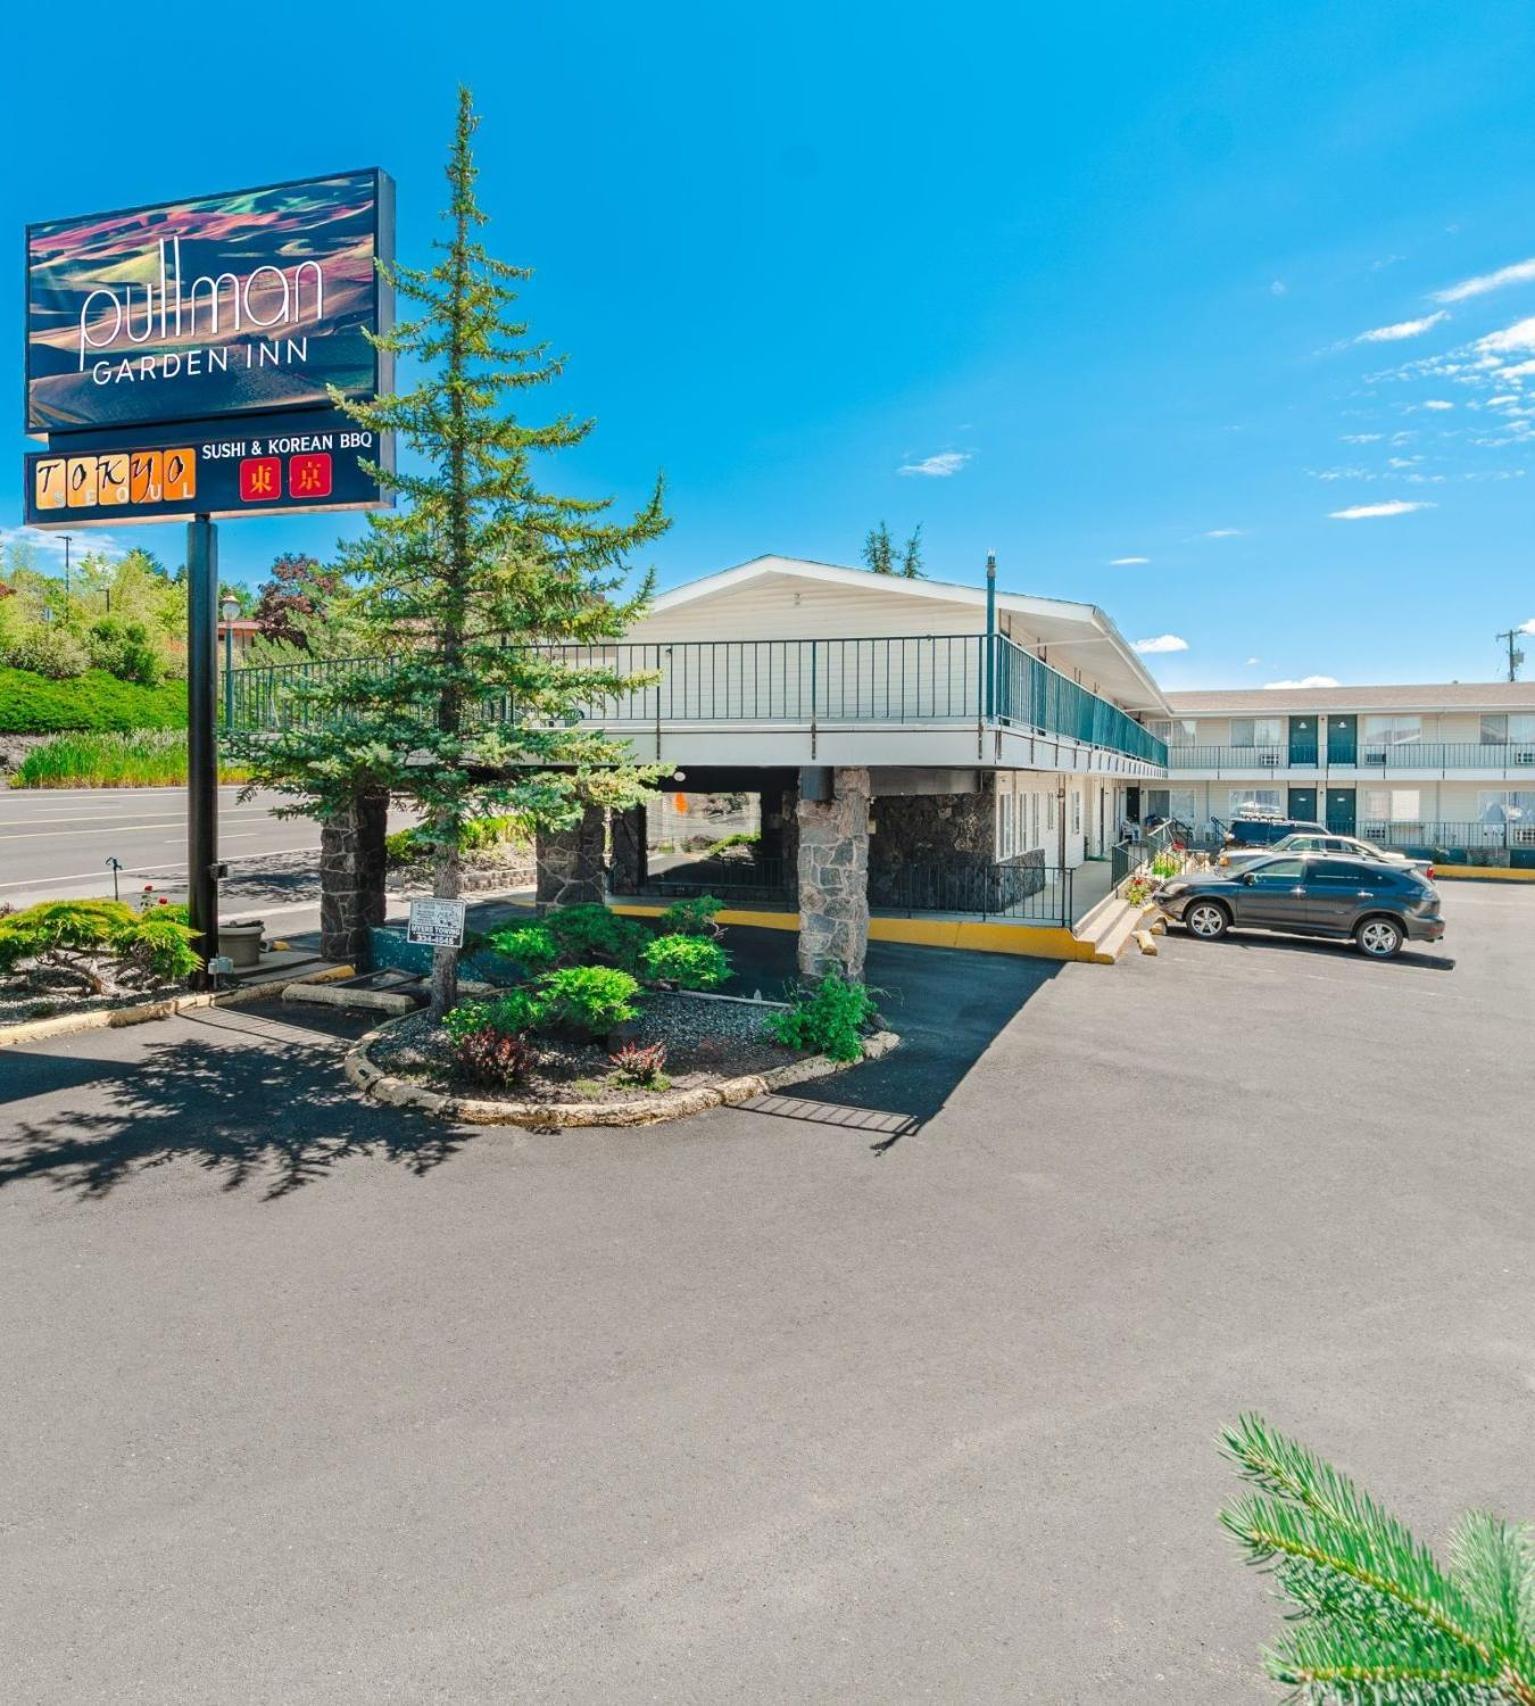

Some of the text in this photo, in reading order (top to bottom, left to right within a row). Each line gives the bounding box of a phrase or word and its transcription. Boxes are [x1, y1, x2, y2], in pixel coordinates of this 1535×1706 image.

[80, 236, 323, 372] pullman
[92, 336, 308, 386] GARDEN INN
[202, 431, 373, 460] SUSHI & KOREAN BBQ
[38, 455, 185, 503] TOKYO
[53, 481, 194, 505] SEOUL
